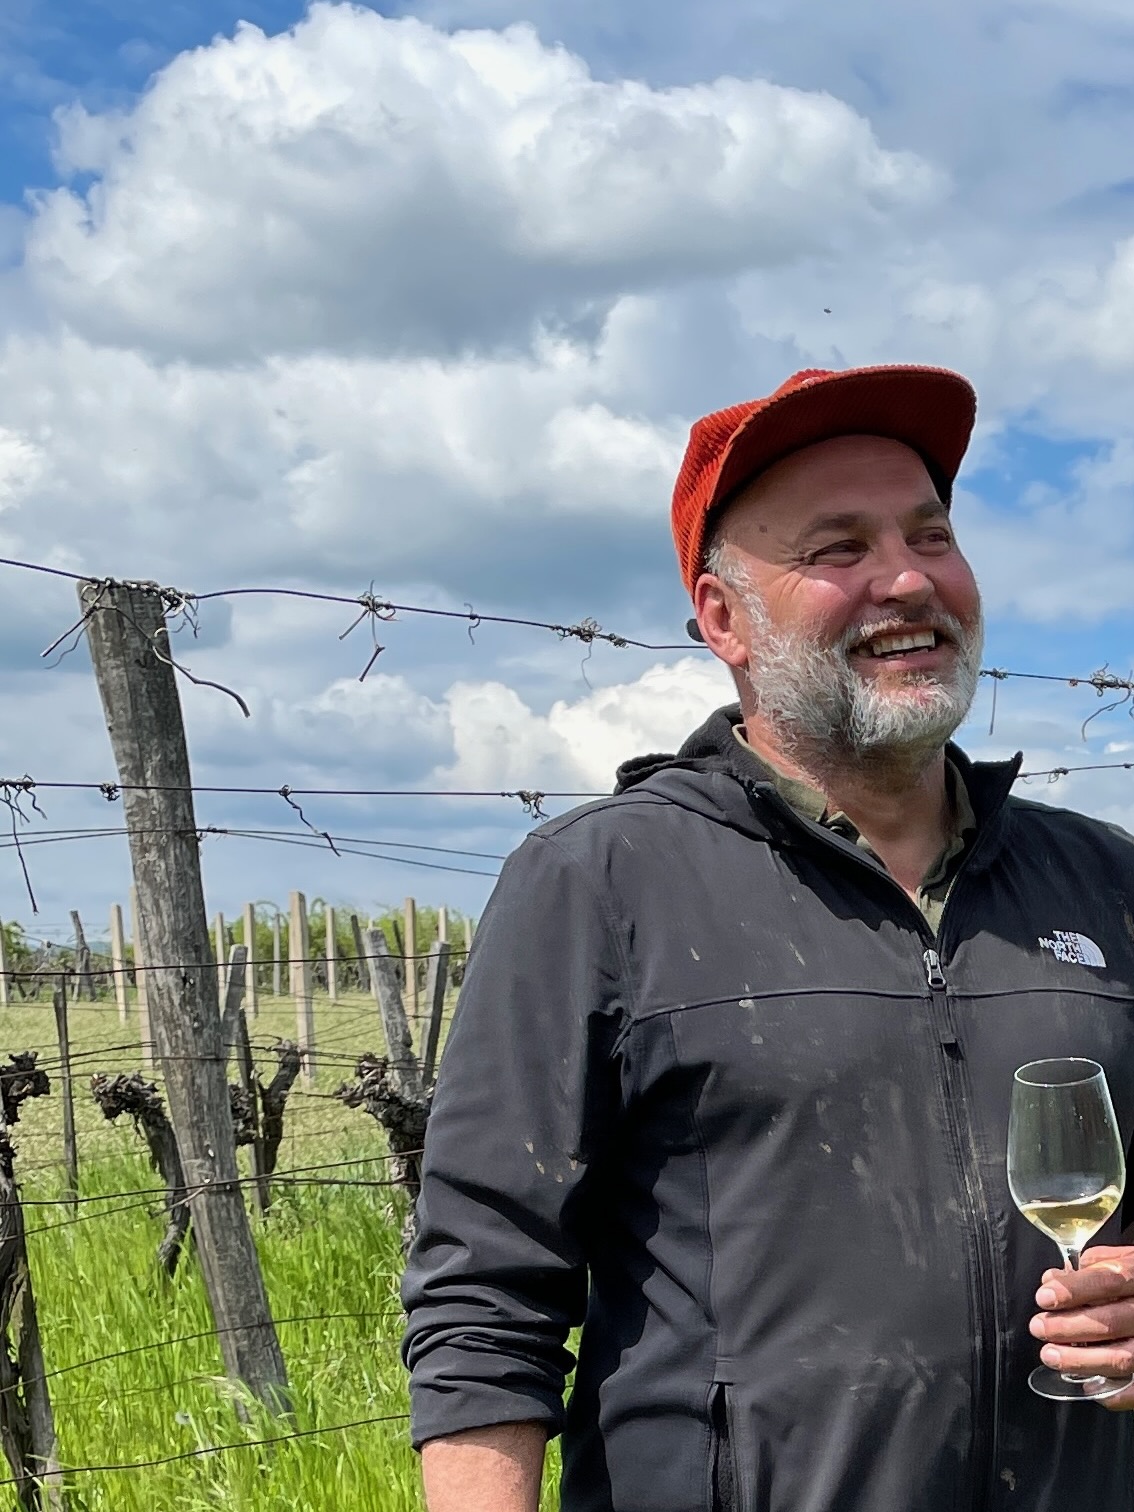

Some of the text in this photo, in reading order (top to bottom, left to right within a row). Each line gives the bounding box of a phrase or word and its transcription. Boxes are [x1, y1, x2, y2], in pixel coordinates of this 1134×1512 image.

[1052, 930, 1079, 944] THE
[1038, 937, 1083, 954] NORTH
[1054, 948, 1086, 964] FACE
